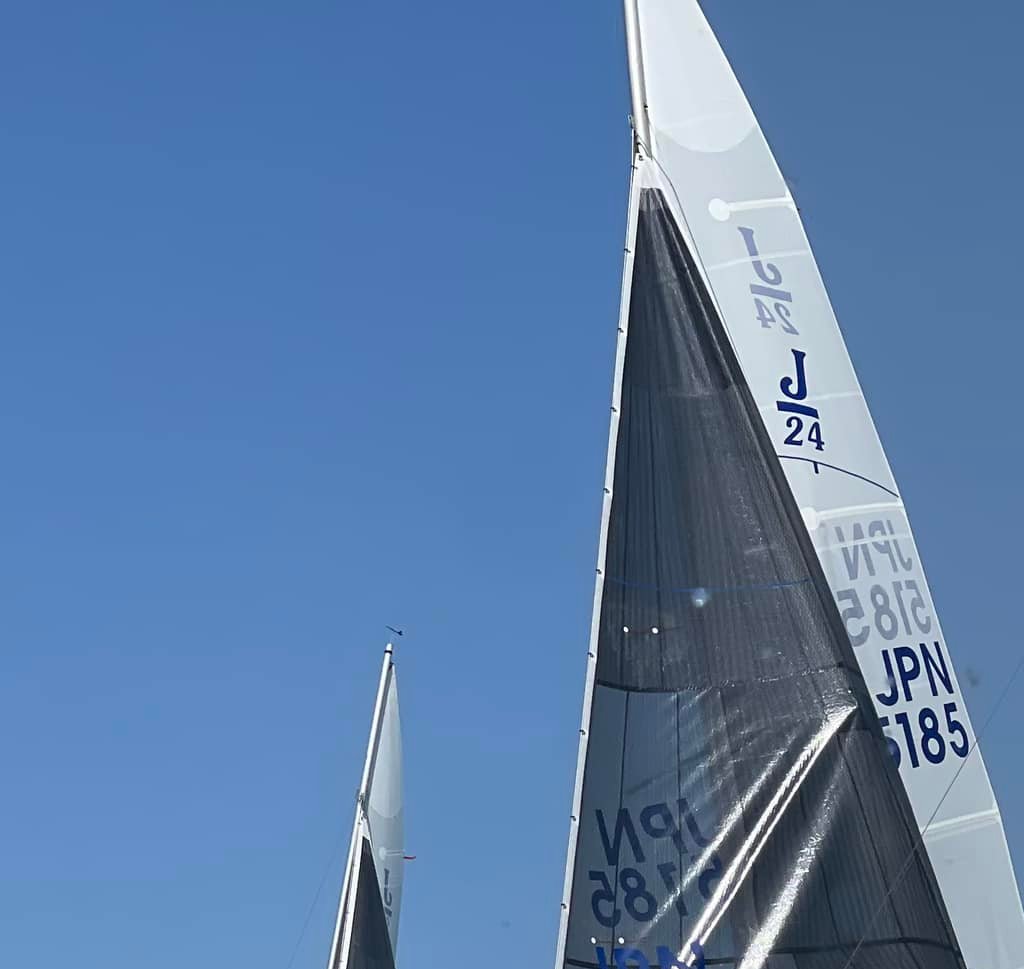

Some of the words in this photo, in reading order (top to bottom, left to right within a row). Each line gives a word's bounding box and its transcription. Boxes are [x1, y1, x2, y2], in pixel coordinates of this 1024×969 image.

[780, 348, 808, 401] J
[783, 416, 825, 451] 24
[876, 641, 954, 707] JPN
